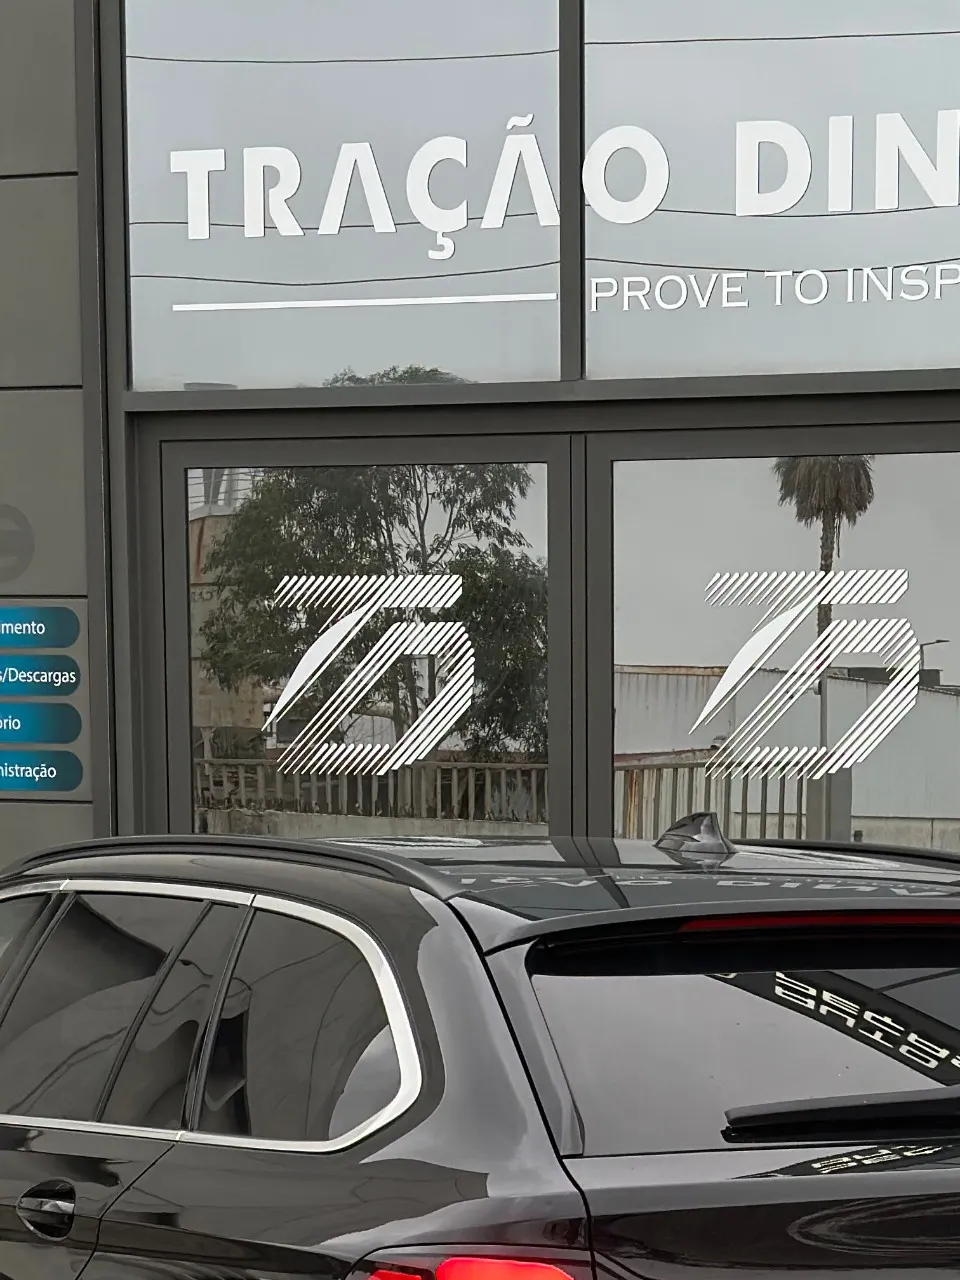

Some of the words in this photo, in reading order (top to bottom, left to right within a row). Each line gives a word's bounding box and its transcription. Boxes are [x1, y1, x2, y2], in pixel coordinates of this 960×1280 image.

[170, 113, 670, 260] TRAÇÃO
[590, 276, 749, 312] PROVE
[764, 269, 828, 306] TO
[0, 621, 46, 635] mento
[0, 714, 21, 730] rio
